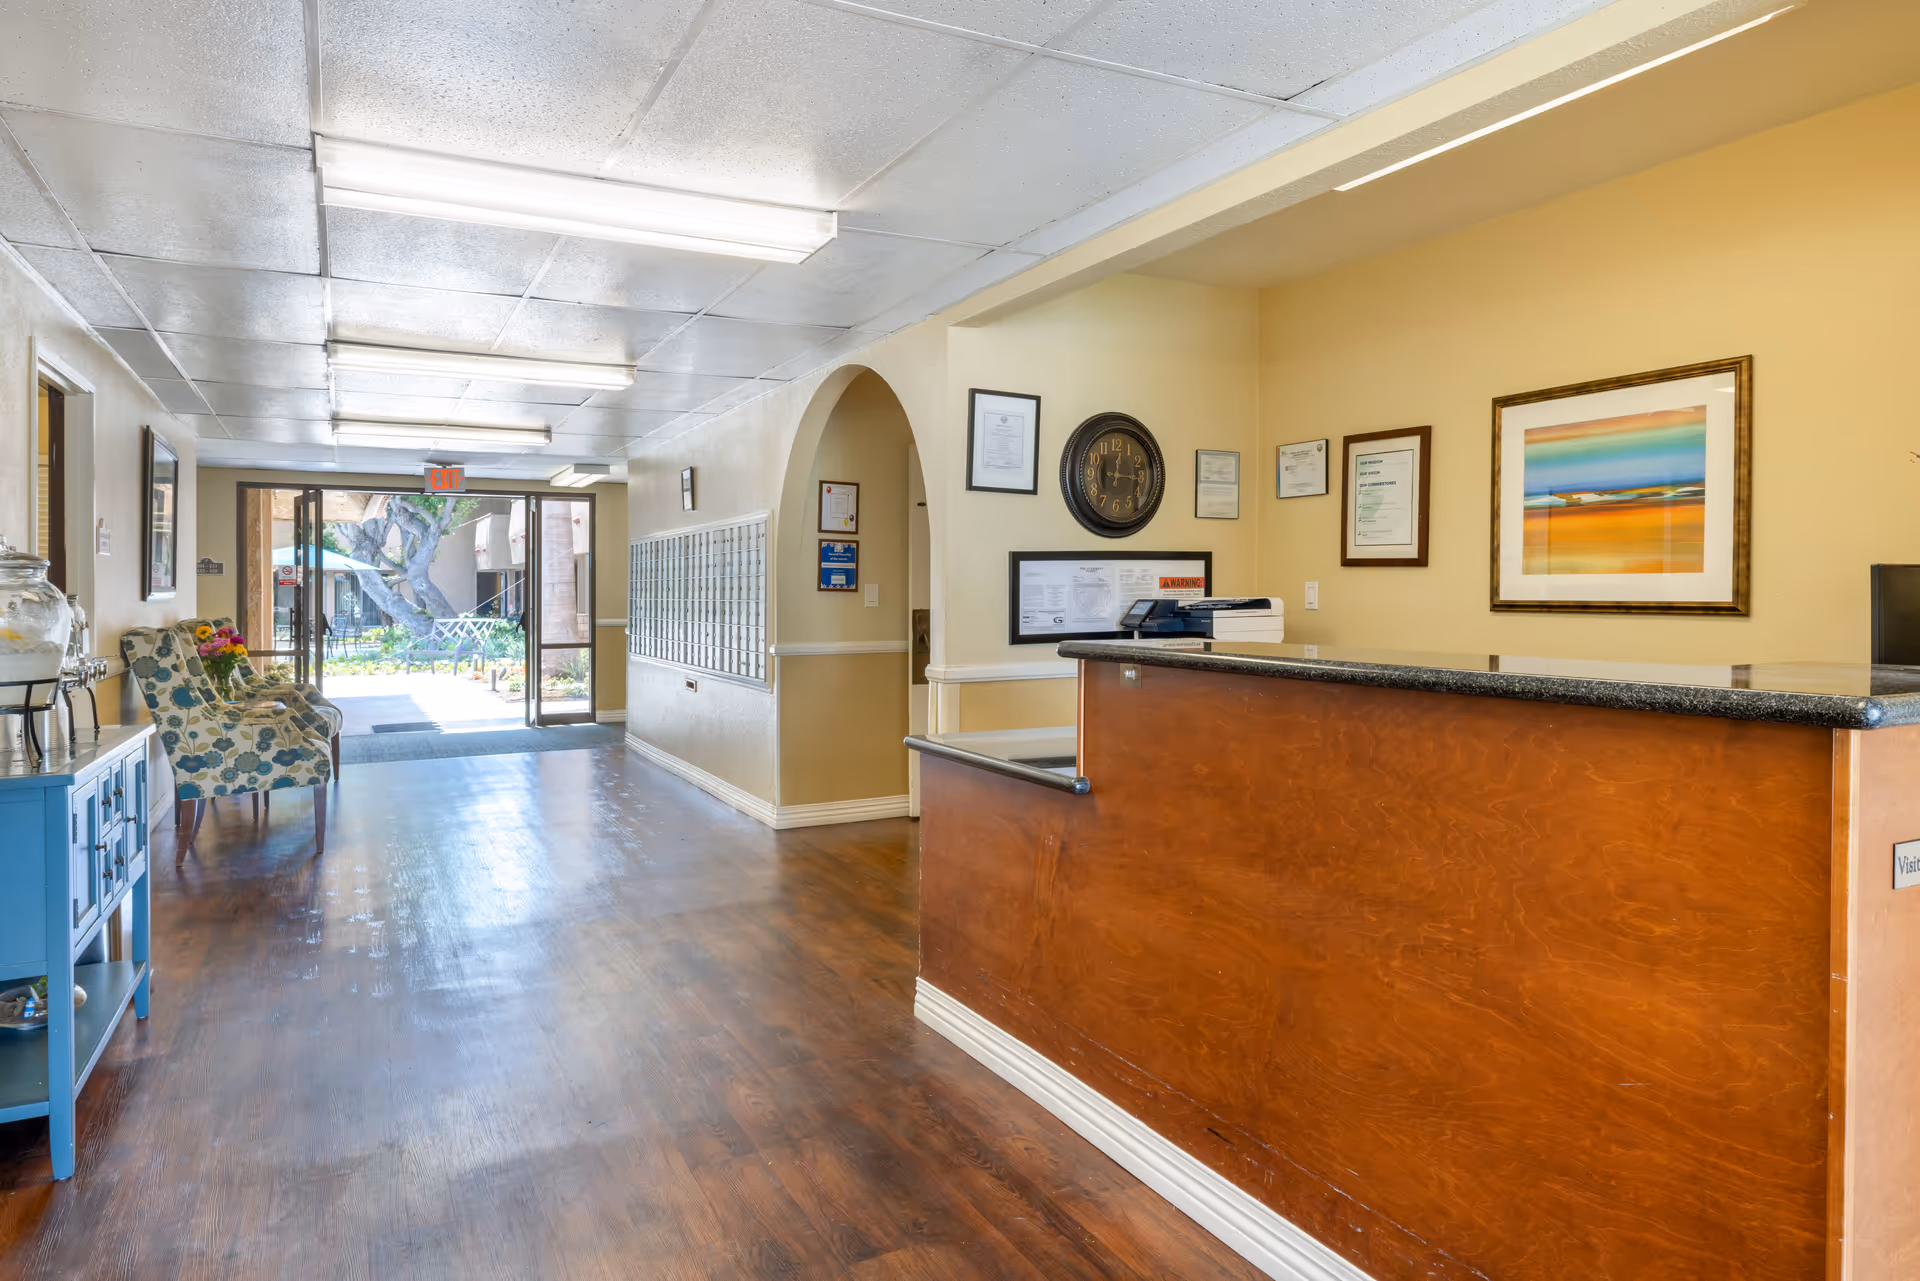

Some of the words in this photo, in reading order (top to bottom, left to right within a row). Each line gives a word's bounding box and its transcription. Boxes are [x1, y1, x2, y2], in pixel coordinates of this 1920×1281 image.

[1100, 442, 1108, 454] 11
[1112, 439, 1121, 451] 12
[1127, 444, 1130, 456] 1
[1090, 452, 1100, 465] 10
[1135, 455, 1141, 467] 2
[432, 469, 460, 489] EXIT
[1087, 468, 1095, 480] 9
[1138, 470, 1144, 483] 3
[1090, 483, 1097, 496] 8
[1134, 485, 1140, 497] 4
[1100, 495, 1107, 507] 7
[1113, 499, 1119, 512] 6
[1125, 496, 1132, 508] 5
[1053, 616, 1064, 624] G
